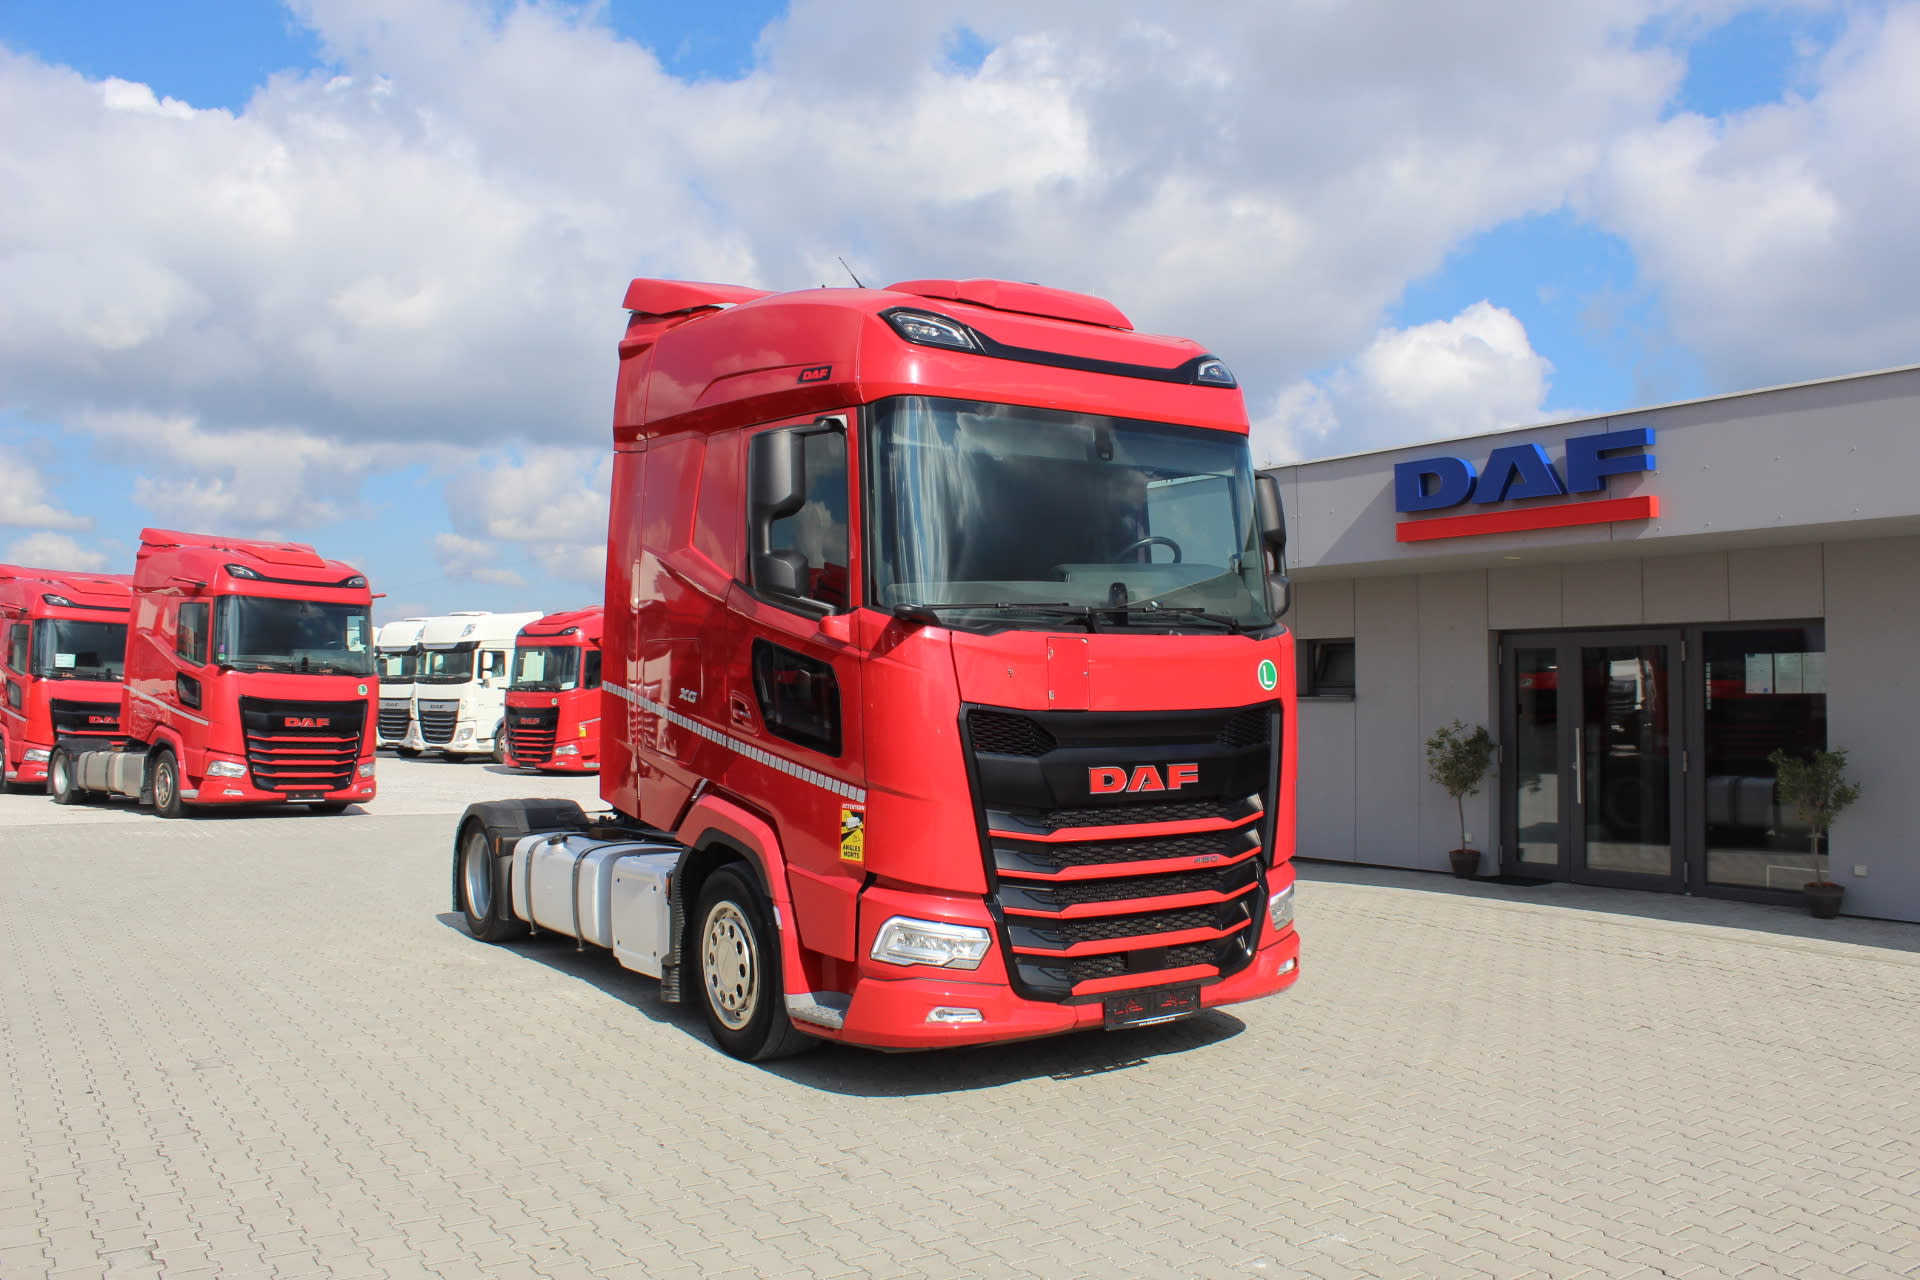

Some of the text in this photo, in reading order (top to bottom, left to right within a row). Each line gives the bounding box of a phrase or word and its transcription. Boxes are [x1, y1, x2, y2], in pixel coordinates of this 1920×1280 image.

[803, 369, 827, 380] DAF
[1394, 427, 1656, 512] DAF
[1263, 664, 1274, 685] L
[679, 688, 697, 703] XG
[89, 715, 120, 724] DA
[284, 717, 330, 727] DAF
[1088, 763, 1199, 794] DAF
[841, 803, 865, 811] ATTENTION
[842, 843, 861, 852] ANGLES
[843, 850, 860, 859] MORTS
